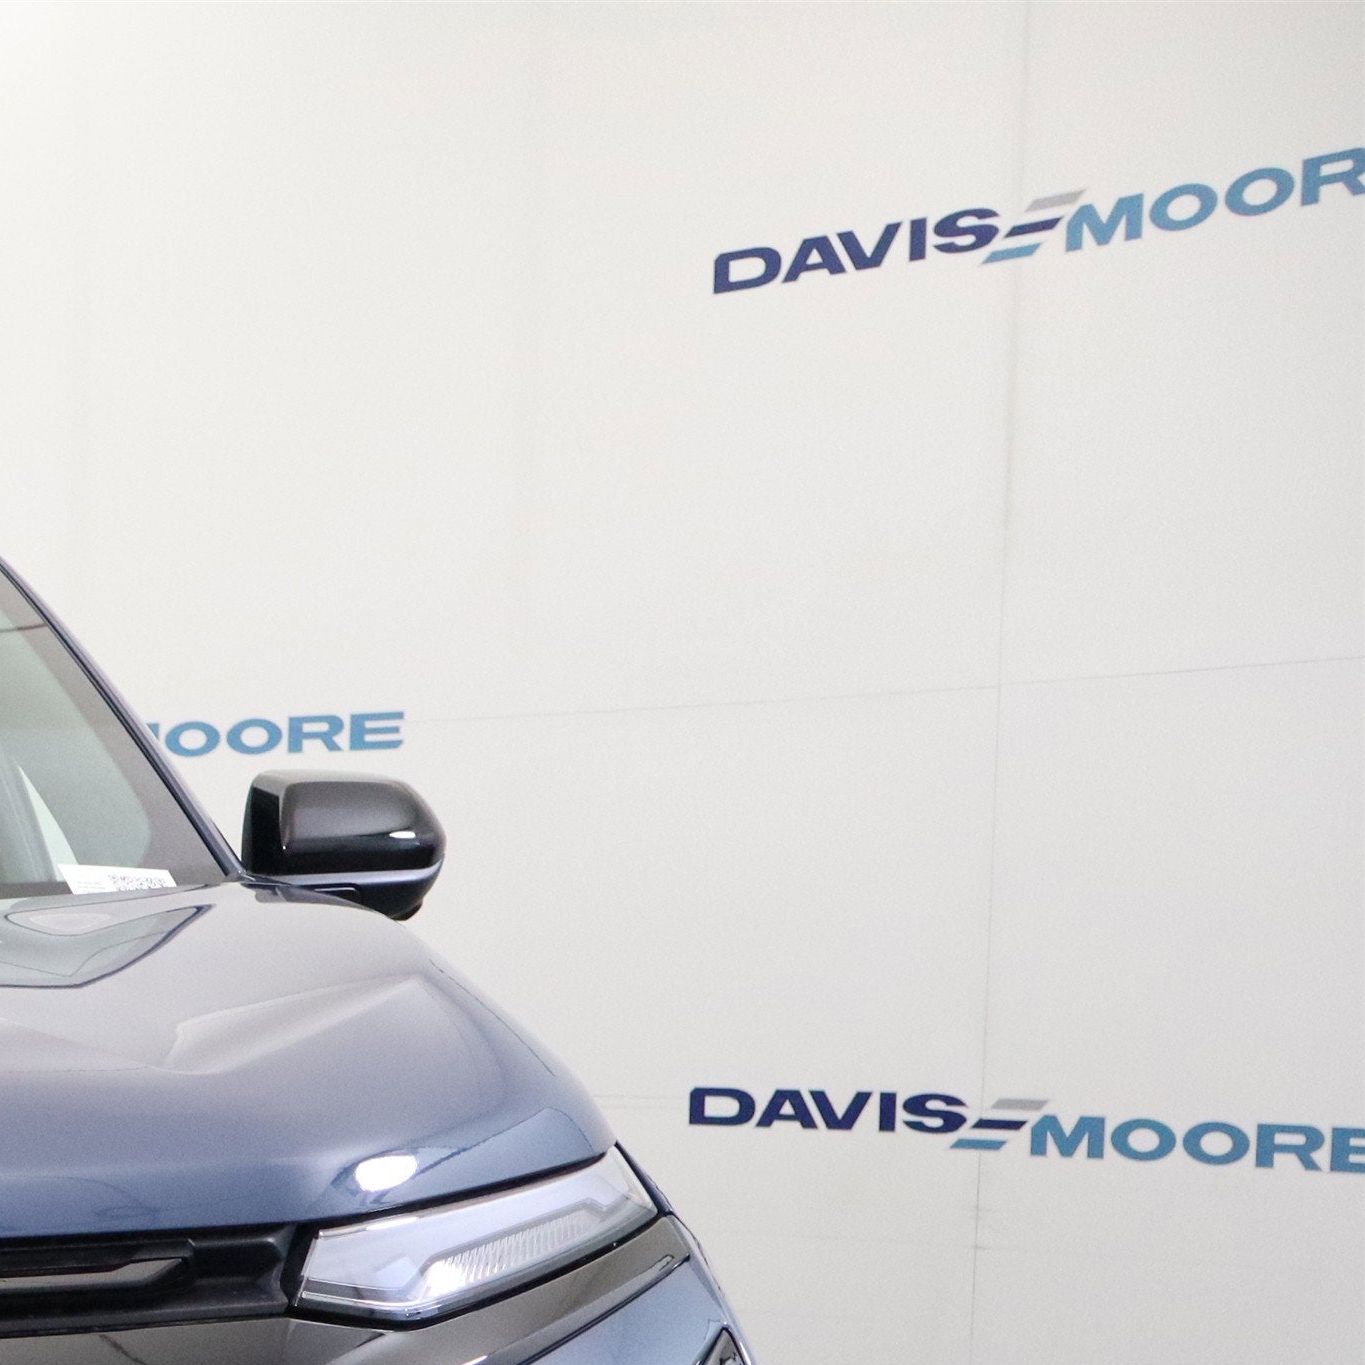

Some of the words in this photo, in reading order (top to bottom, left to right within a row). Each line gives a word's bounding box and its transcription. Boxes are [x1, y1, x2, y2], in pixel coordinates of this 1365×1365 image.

[712, 207, 1000, 294] DAVIS
[146, 711, 405, 757] OORE
[688, 1086, 968, 1134] DAVIS
